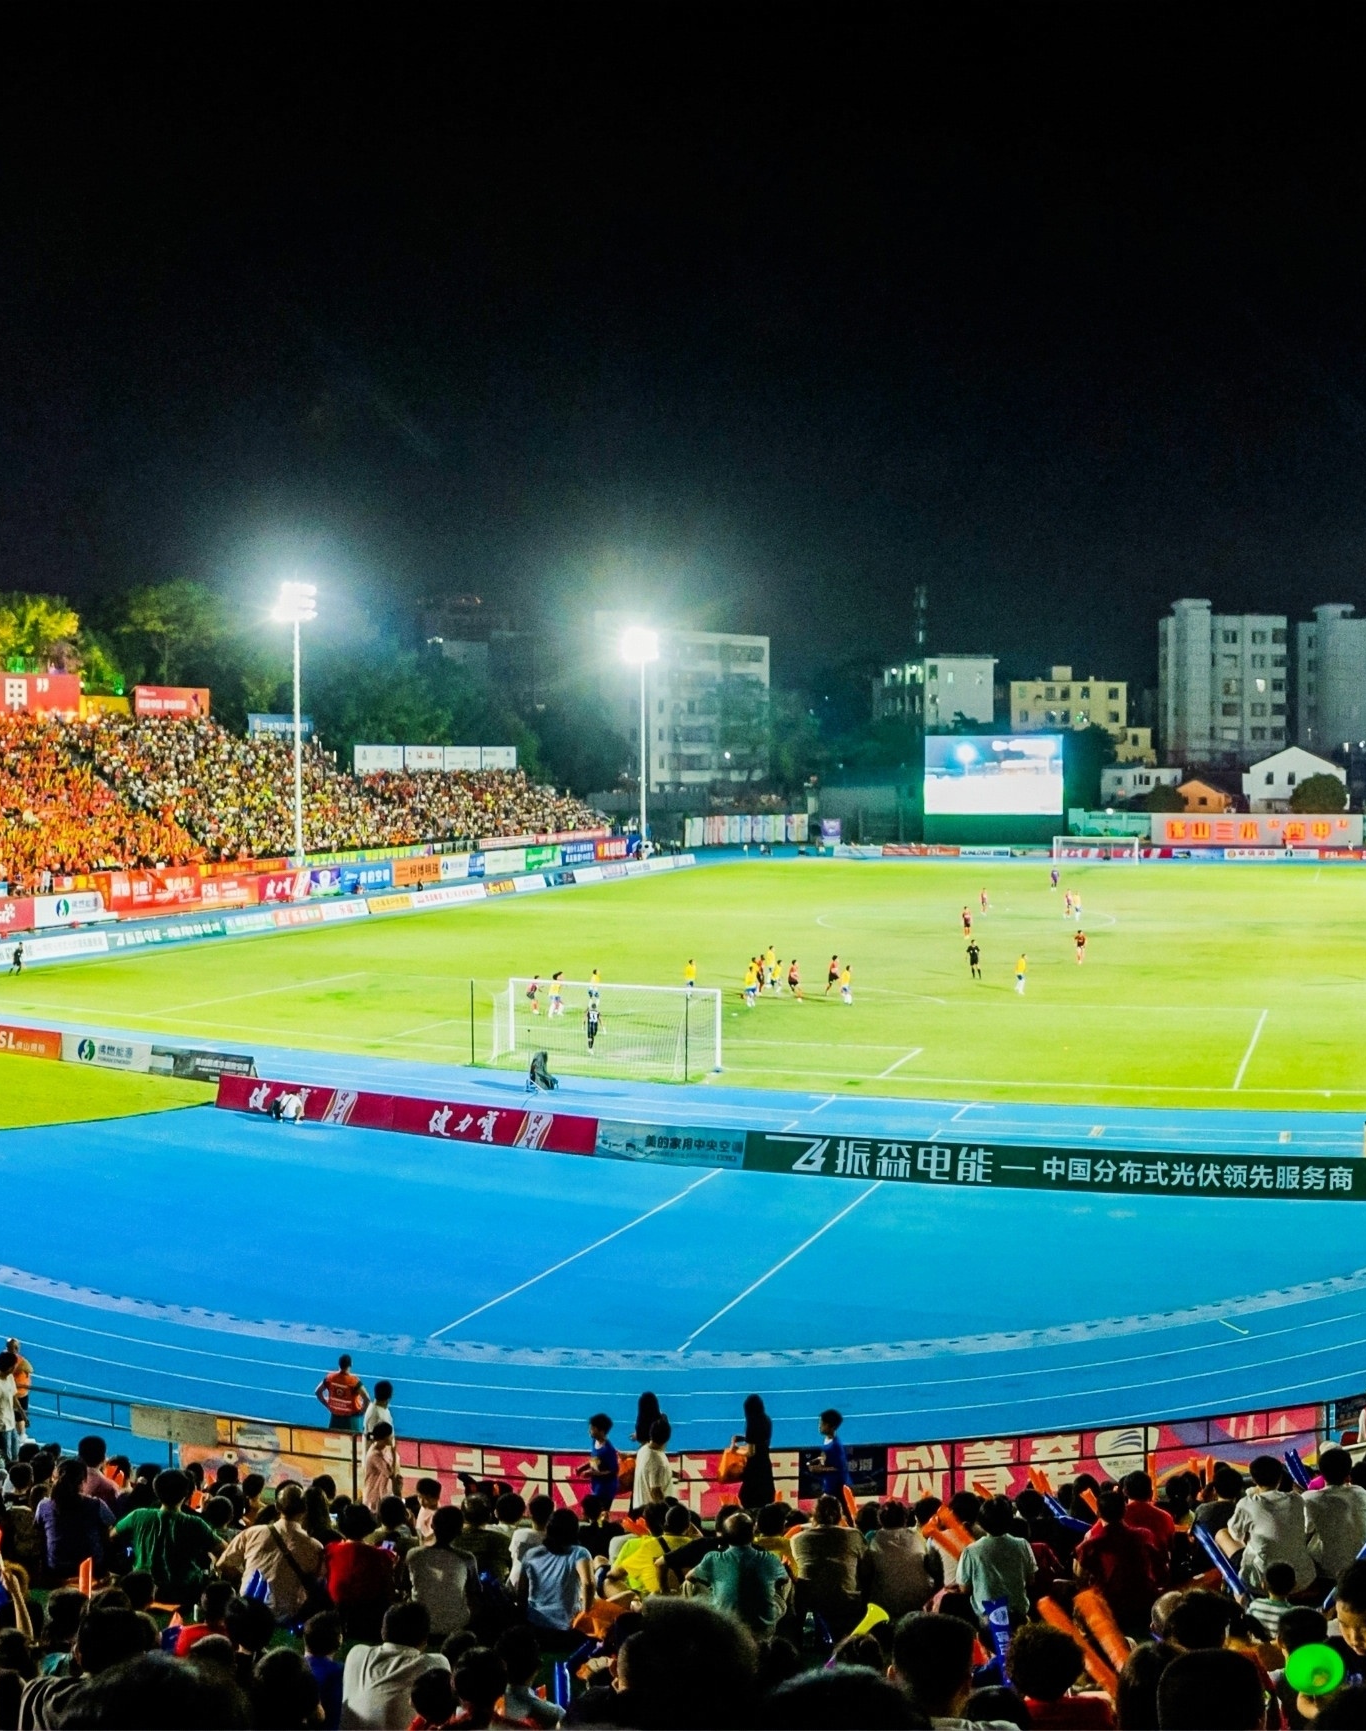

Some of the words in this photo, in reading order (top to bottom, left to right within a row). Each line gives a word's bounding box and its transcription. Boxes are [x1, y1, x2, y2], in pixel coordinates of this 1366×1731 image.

[645, 1133, 745, 1154] 美的家用中央空调
[834, 1139, 994, 1183] 振森电能
[1041, 1155, 1354, 1192] 中国分布式光伏领先服务商
